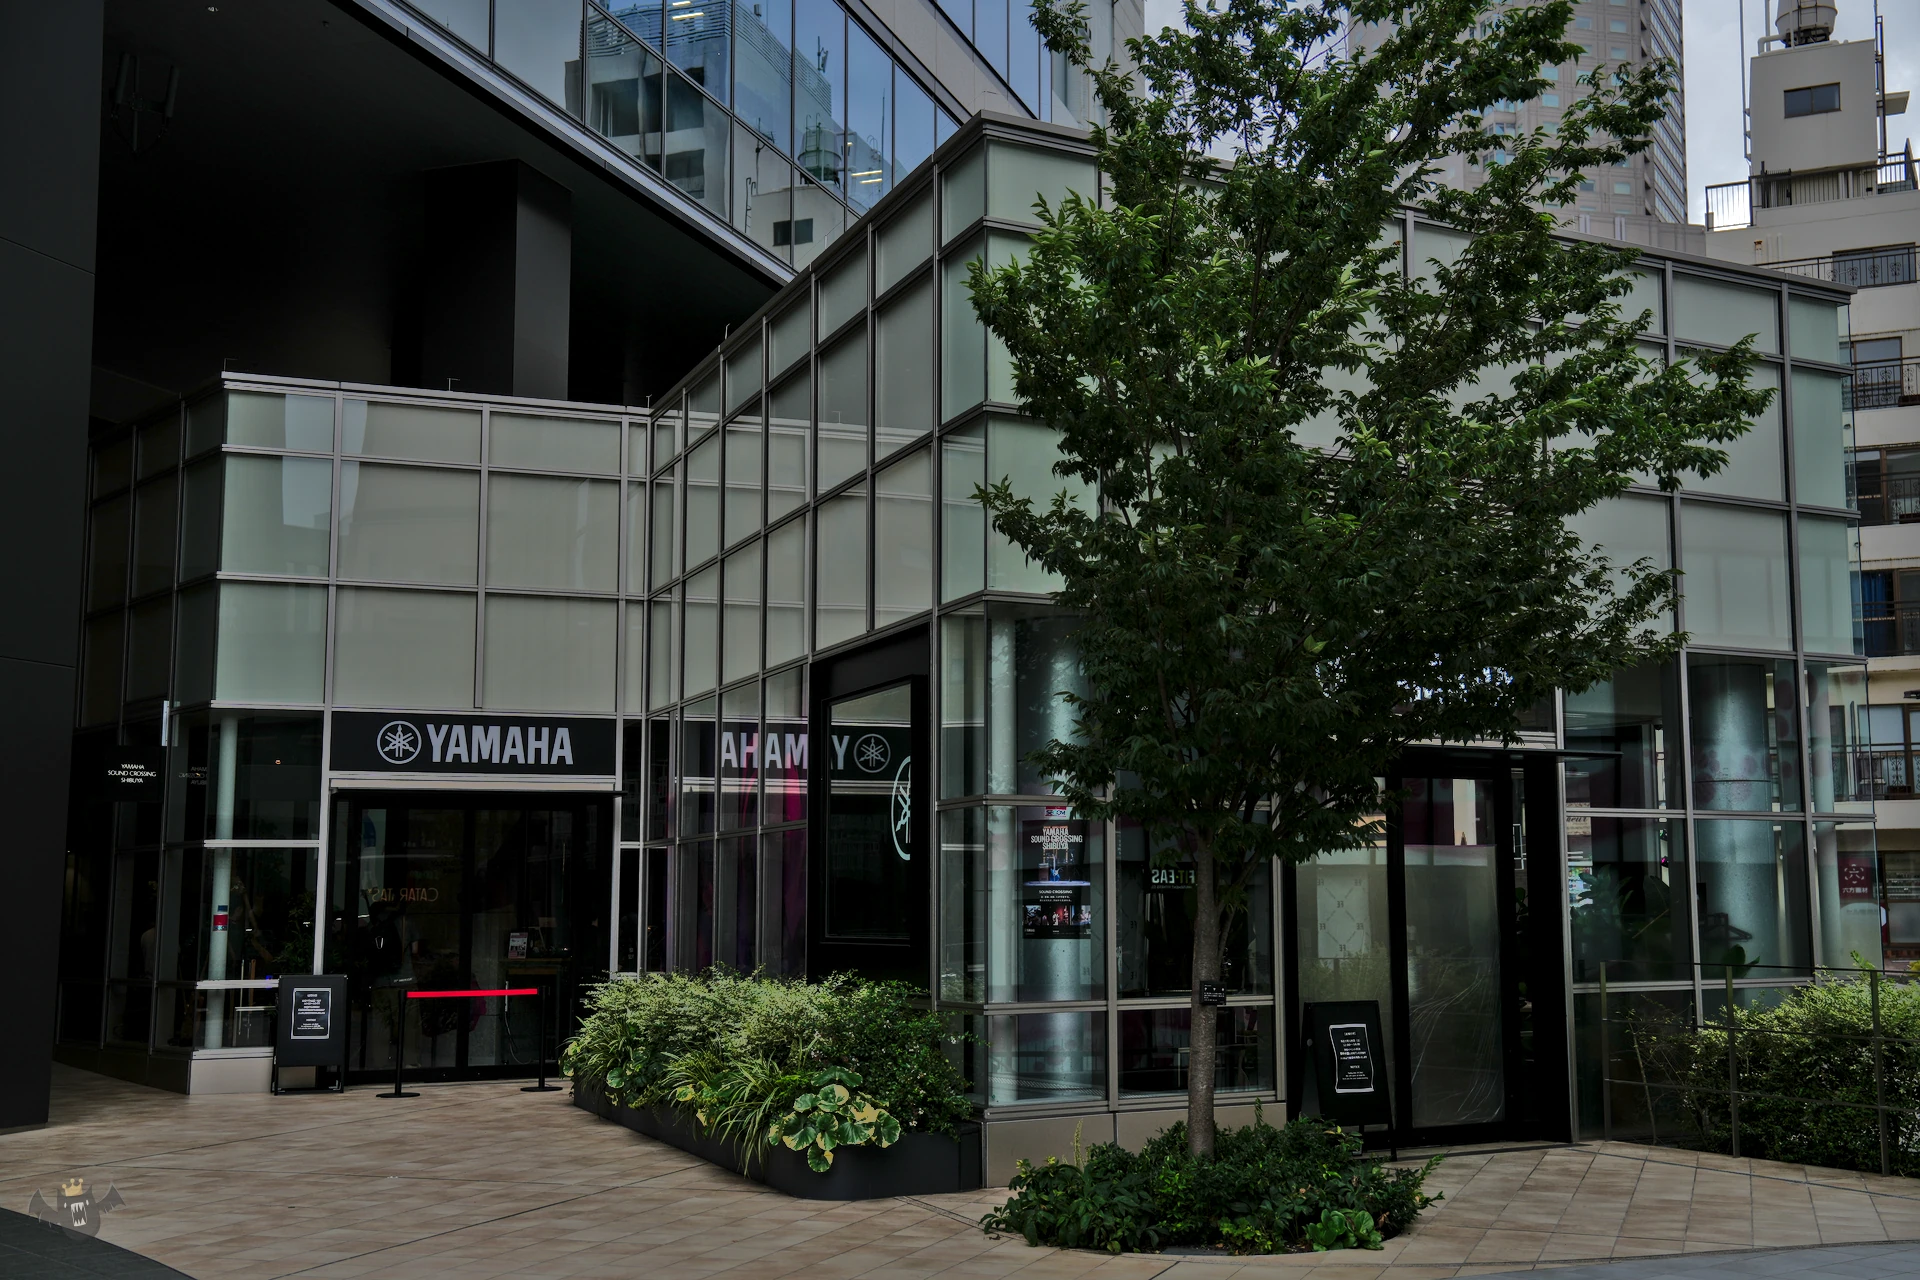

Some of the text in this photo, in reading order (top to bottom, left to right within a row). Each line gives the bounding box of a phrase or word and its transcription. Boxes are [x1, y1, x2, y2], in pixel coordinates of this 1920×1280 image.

[426, 723, 574, 765] YAMAHA
[1030, 835, 1083, 843] SOUND CROSSING
